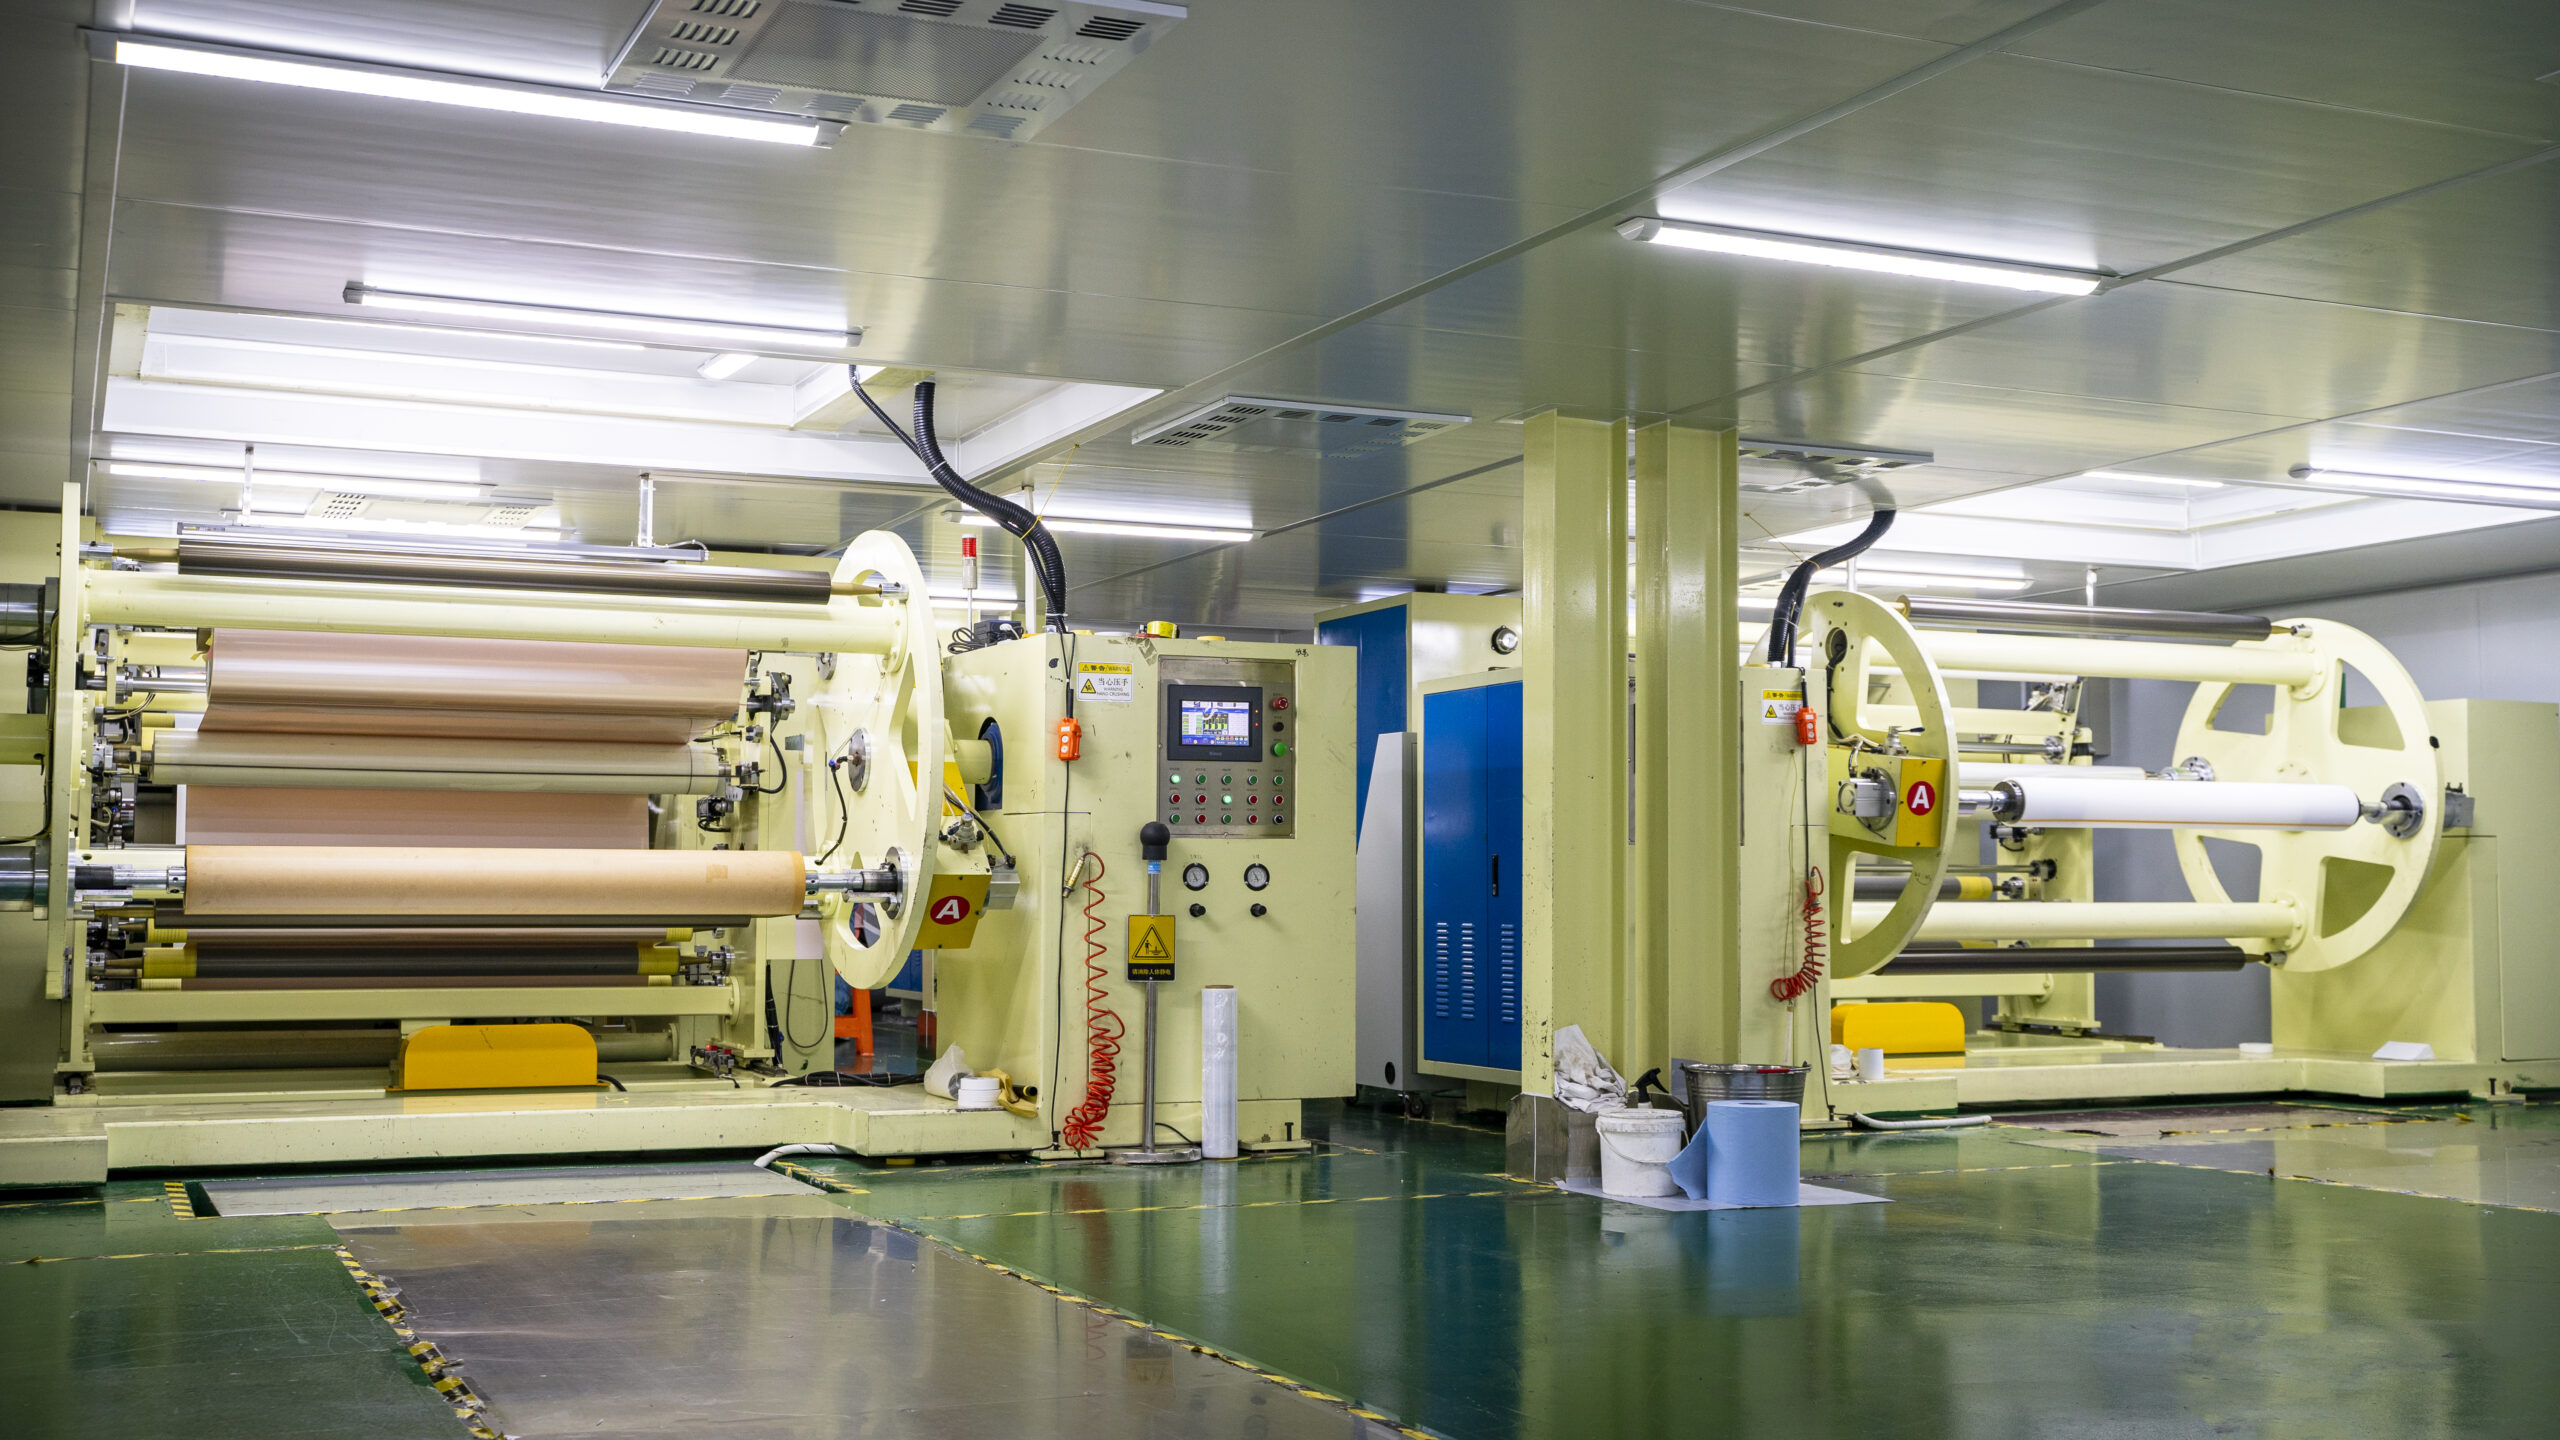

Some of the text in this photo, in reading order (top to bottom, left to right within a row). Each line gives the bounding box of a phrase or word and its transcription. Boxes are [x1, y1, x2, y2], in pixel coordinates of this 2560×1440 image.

[1098, 677, 1128, 686] 当心压手
[1911, 785, 1930, 809] A
[935, 899, 960, 920] A
